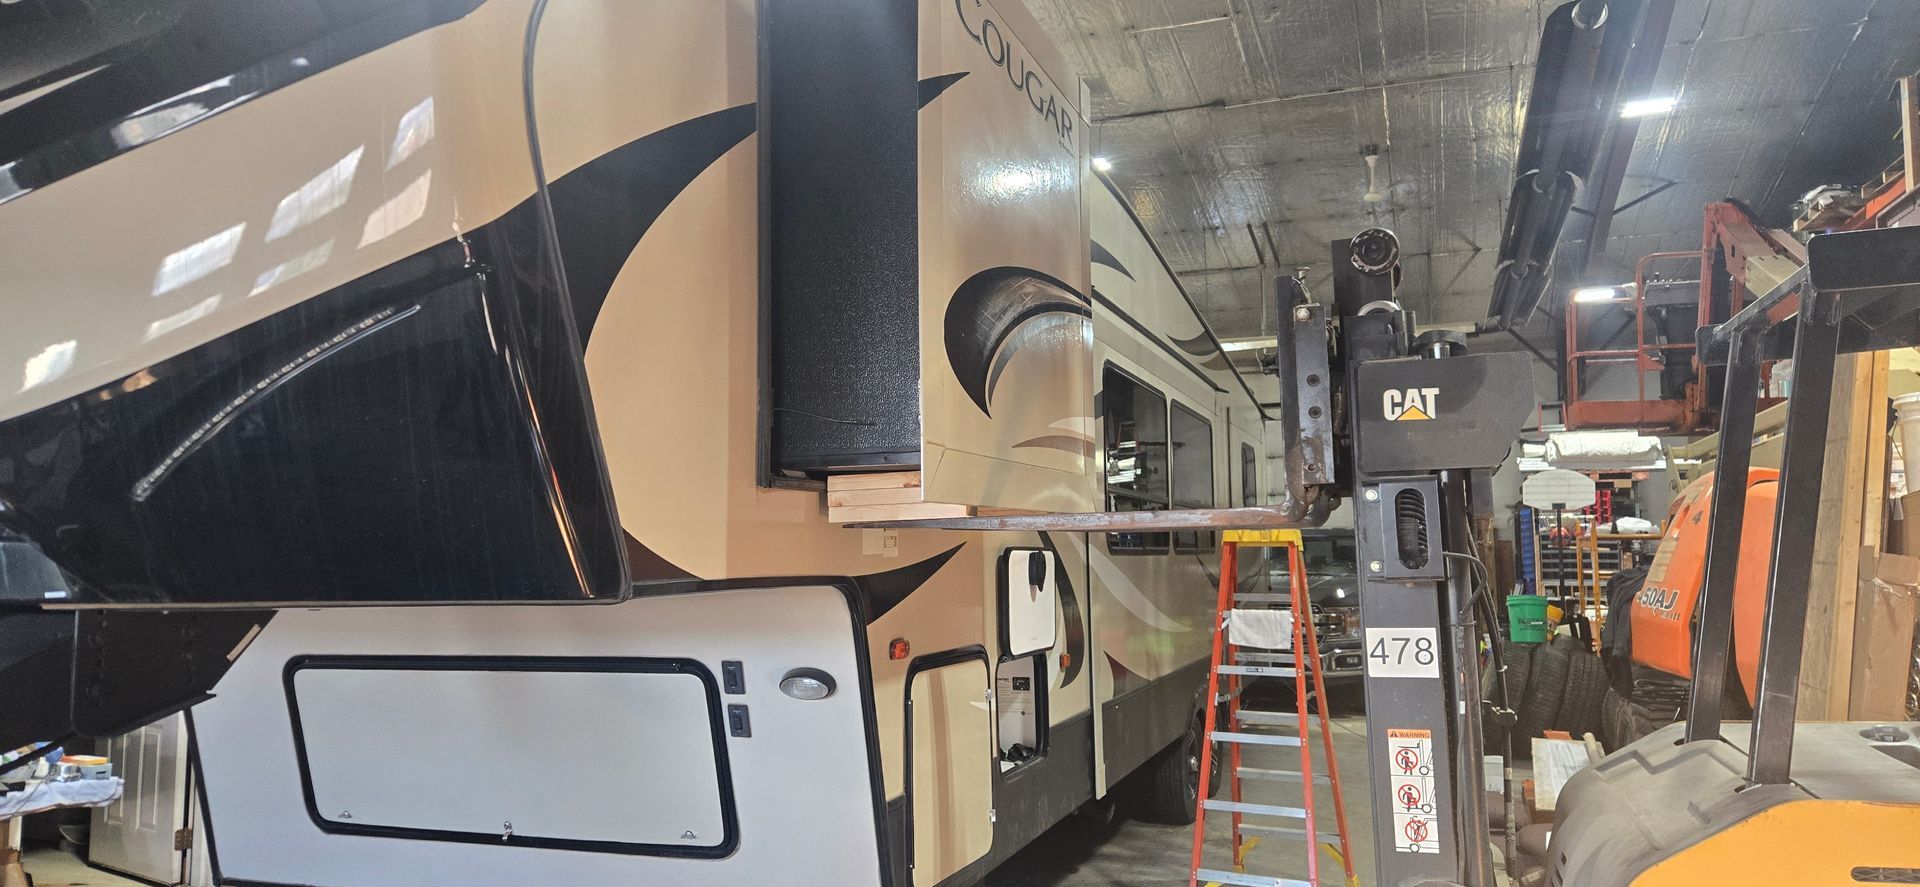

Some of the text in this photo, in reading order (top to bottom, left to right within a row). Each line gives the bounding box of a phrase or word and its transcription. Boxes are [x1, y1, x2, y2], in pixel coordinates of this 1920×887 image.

[955, 0, 1075, 150] COUGAR
[1383, 387, 1440, 421] CAT
[1369, 637, 1434, 665] 478
[1399, 731, 1430, 739] WARNING
